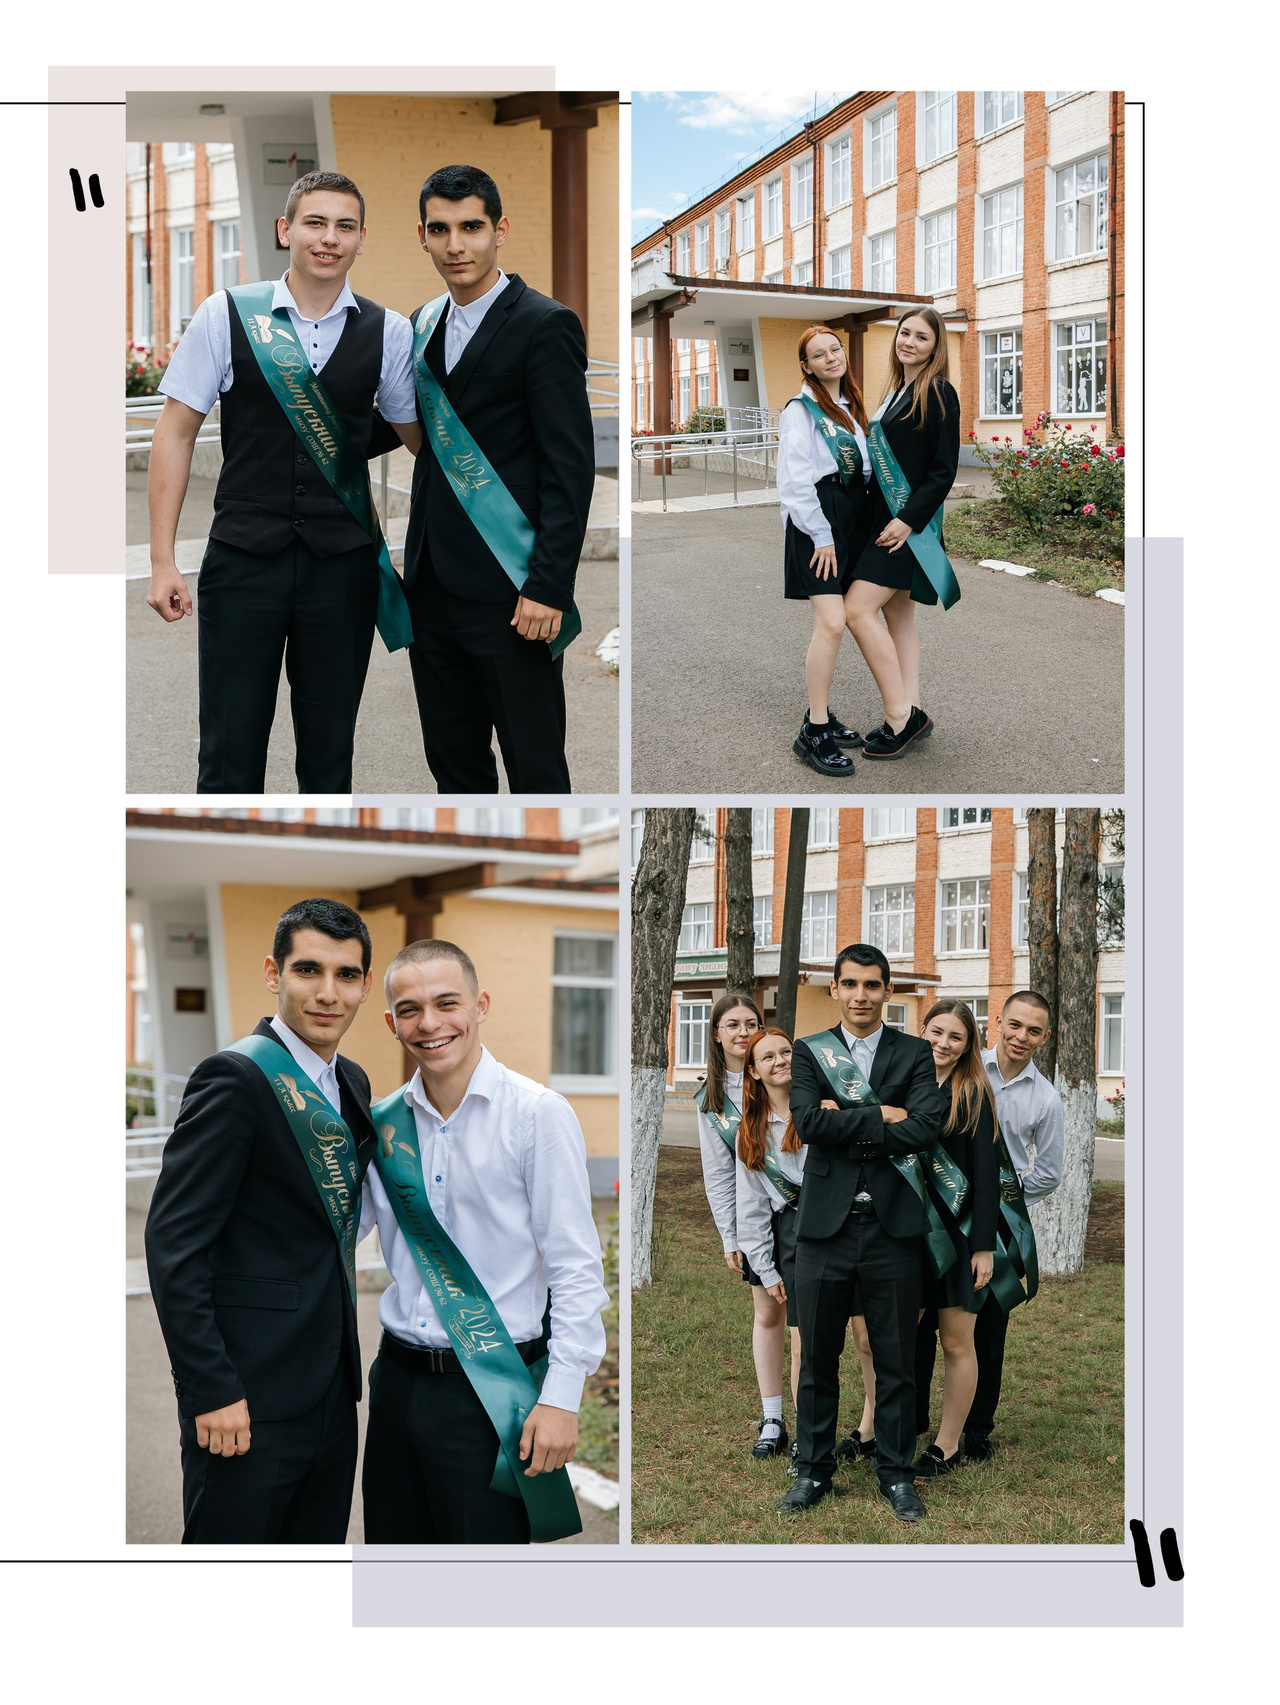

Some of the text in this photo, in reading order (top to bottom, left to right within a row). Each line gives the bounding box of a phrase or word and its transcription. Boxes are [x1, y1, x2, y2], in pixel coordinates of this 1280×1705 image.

[271, 344, 340, 459] Выпускник
[293, 413, 310, 435] МБОУ
[305, 434, 320, 451] СОШ
[452, 449, 492, 491] 2024
[283, 1094, 296, 1114] класс
[326, 1194, 340, 1217] МБОУ
[999, 1177, 1020, 1203] 2024
[414, 1243, 431, 1269] МБОУ
[425, 1268, 440, 1288] СОШ
[439, 1296, 448, 1306] 62
[459, 1304, 504, 1353] 2024
